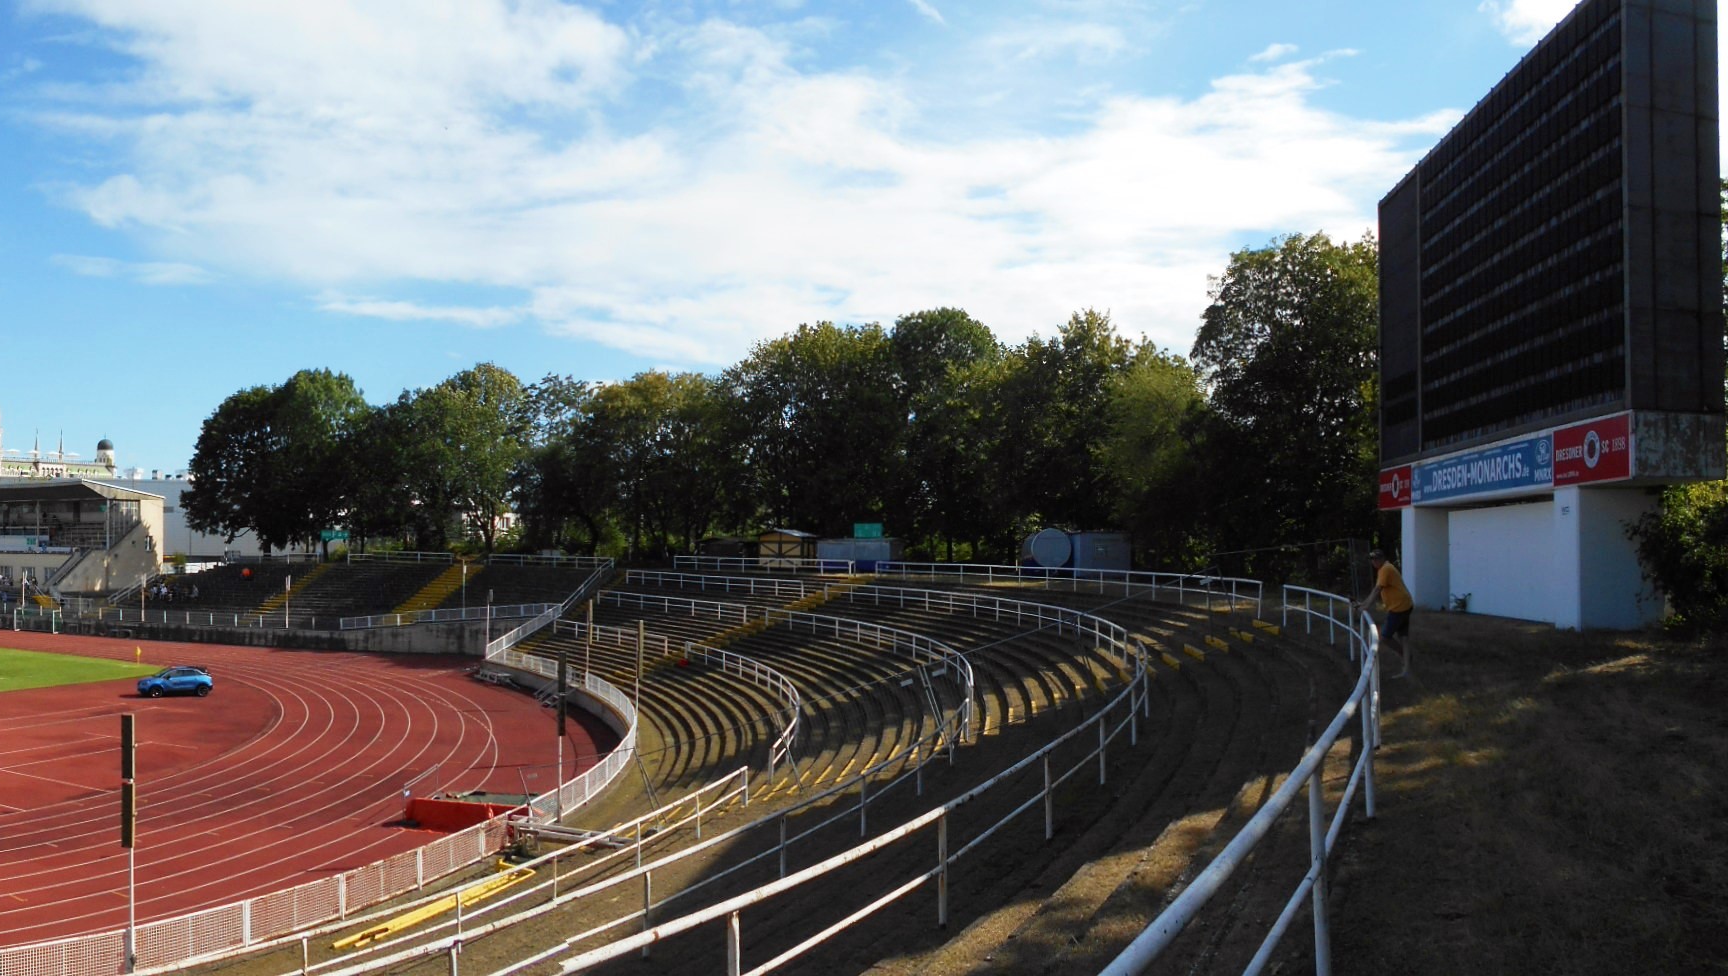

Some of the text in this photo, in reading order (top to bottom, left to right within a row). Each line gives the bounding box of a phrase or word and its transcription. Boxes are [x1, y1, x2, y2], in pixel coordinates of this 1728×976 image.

[1556, 445, 1583, 462] DRESDNER
[1601, 440, 1610, 454] SC
[1612, 436, 1626, 452] 1898
